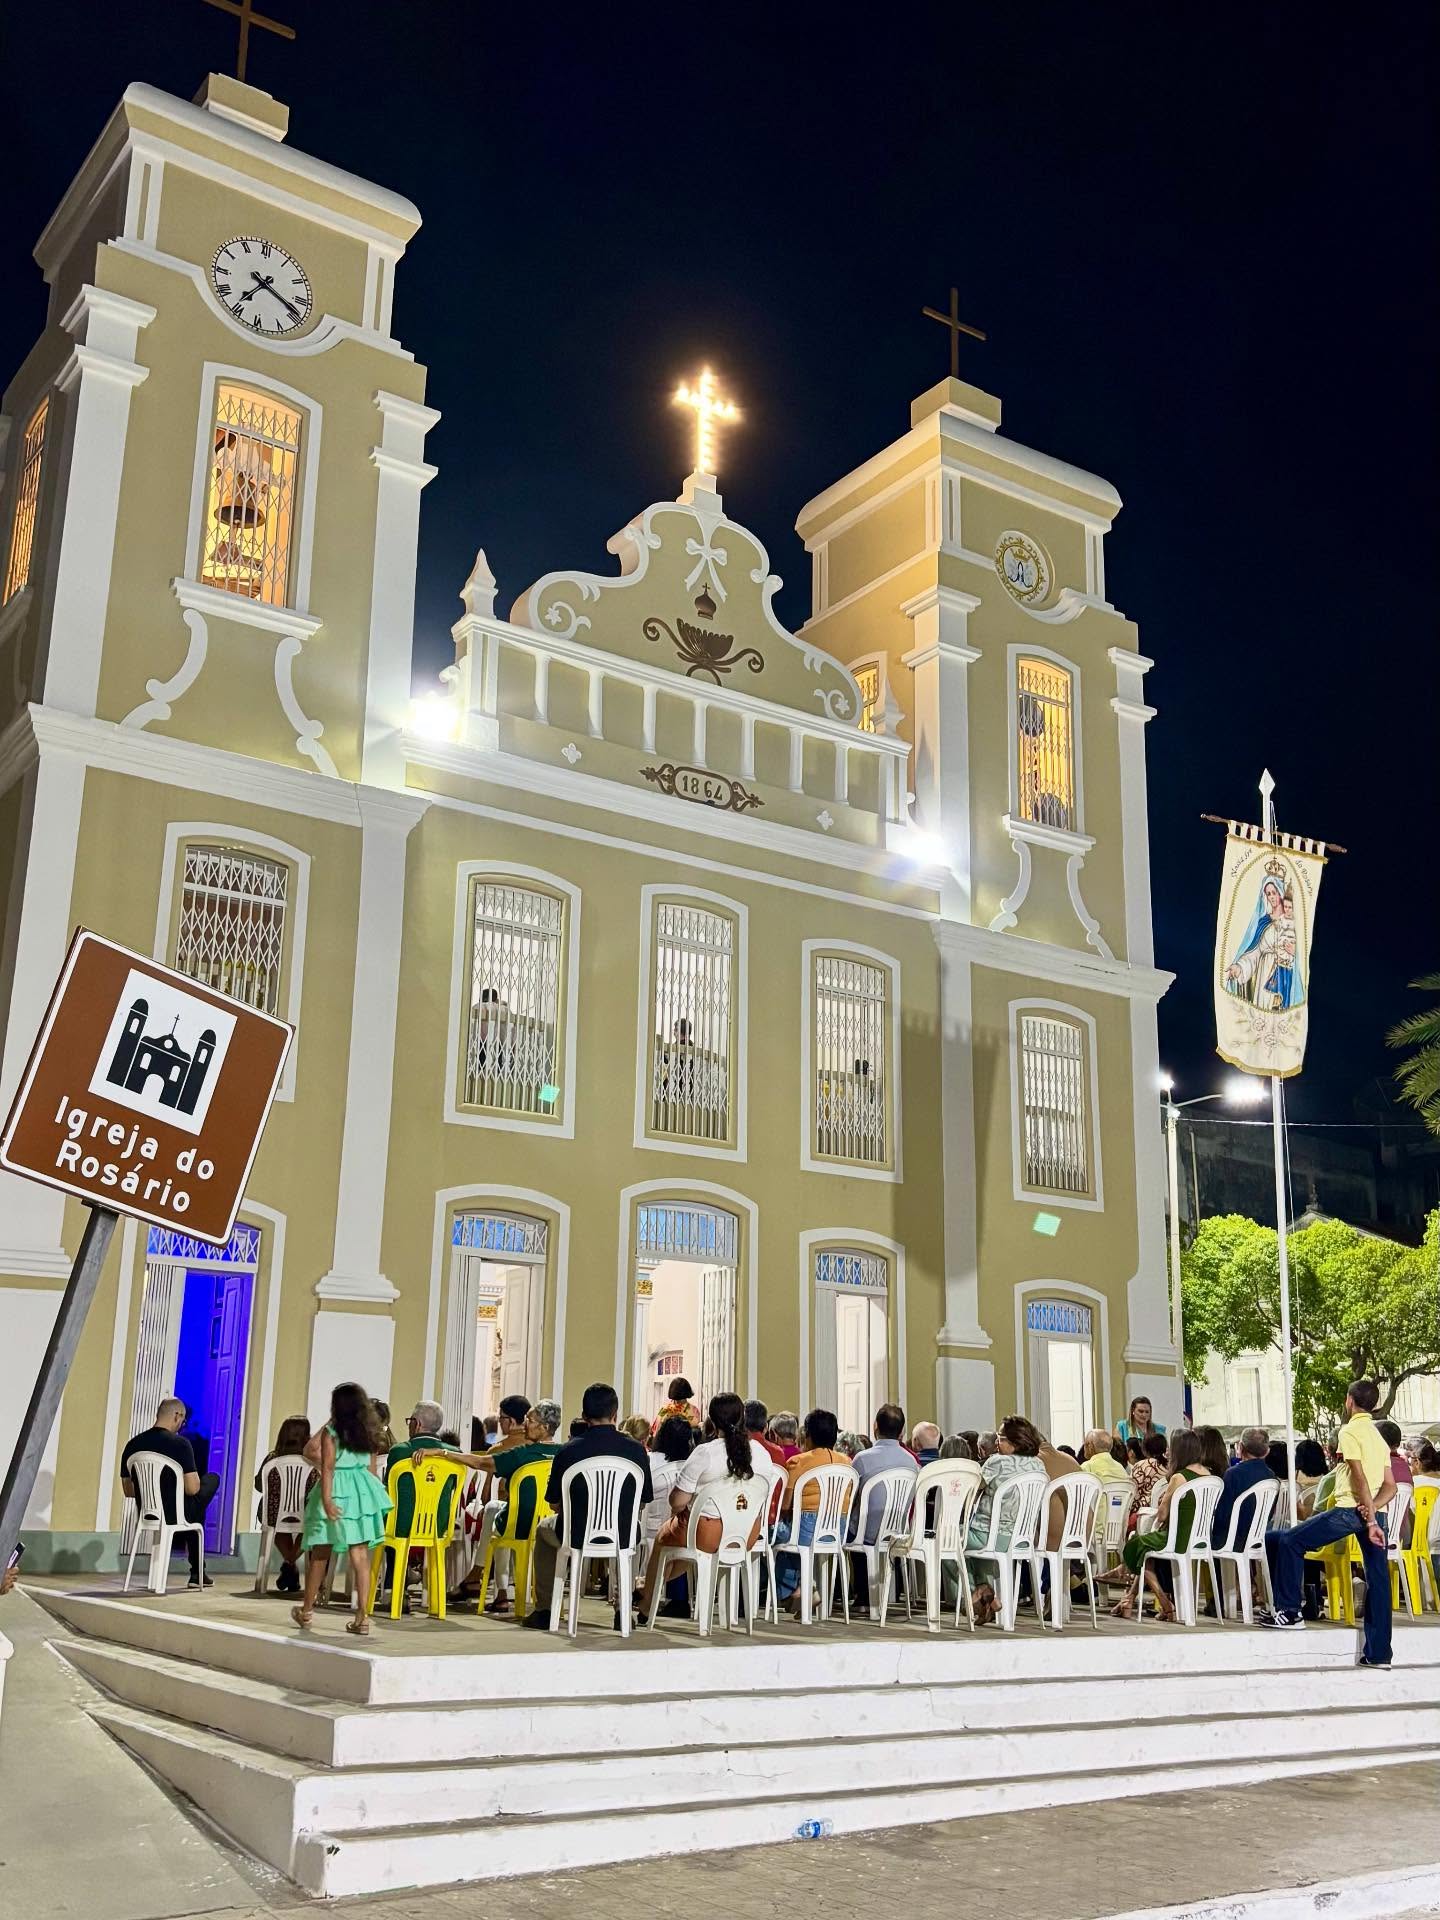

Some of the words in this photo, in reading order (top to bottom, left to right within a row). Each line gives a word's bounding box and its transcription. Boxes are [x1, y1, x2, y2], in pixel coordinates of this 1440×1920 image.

[261, 243, 271, 258] XII
[276, 319, 283, 330] V
[682, 775, 723, 801] 1864
[55, 1095, 159, 1160] Igreja
[176, 1148, 215, 1180] do
[55, 1138, 190, 1213] Rosário
